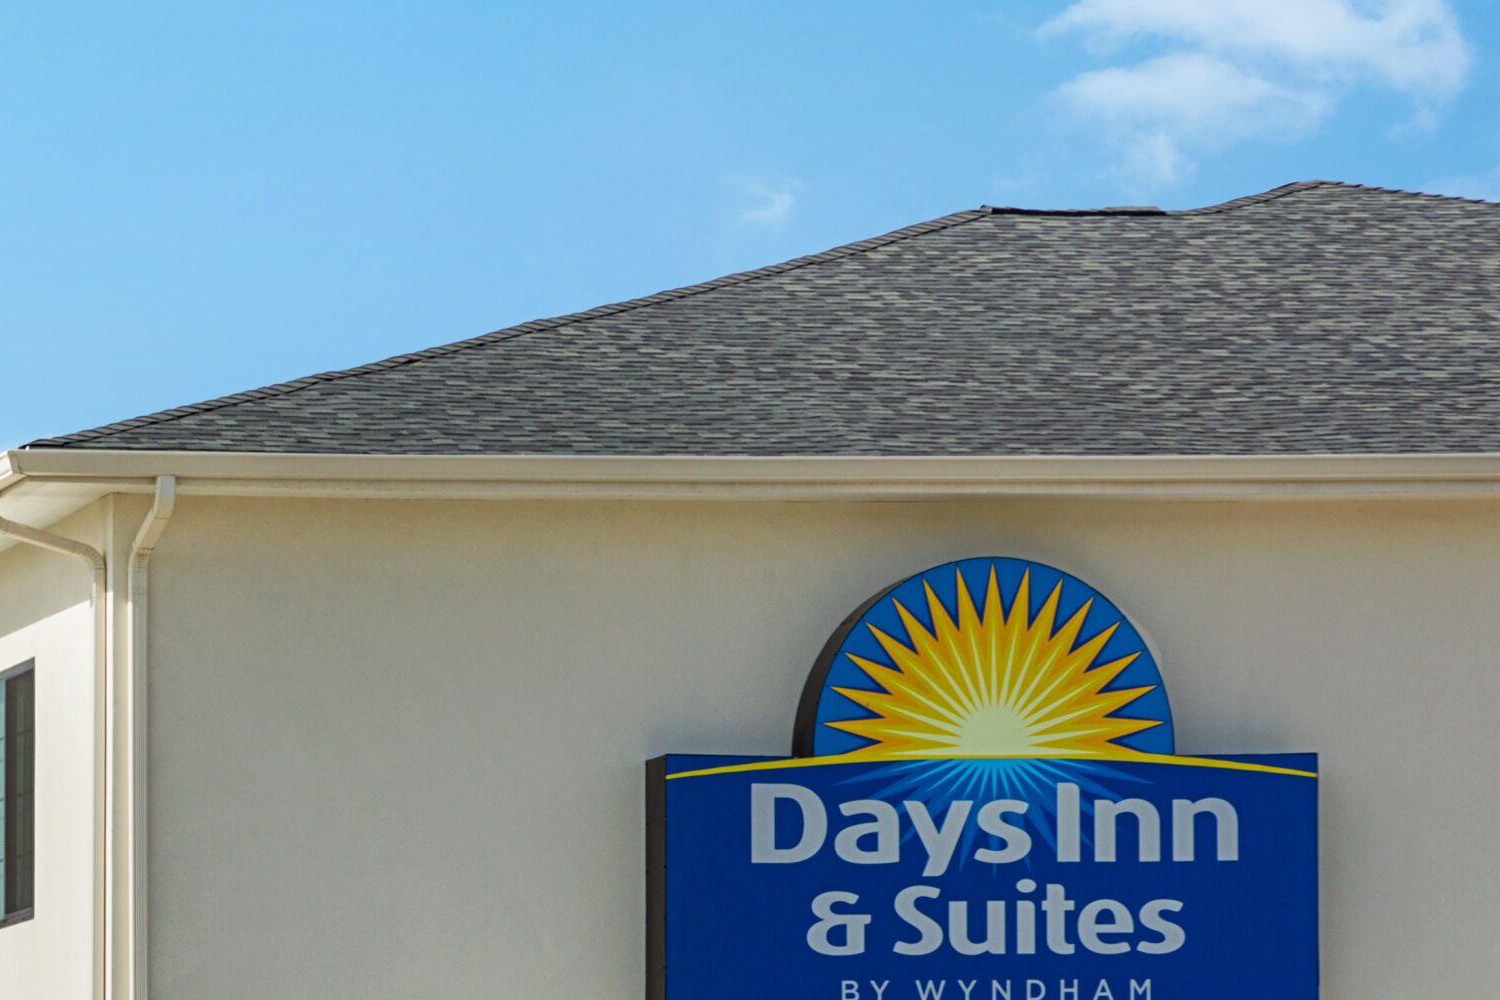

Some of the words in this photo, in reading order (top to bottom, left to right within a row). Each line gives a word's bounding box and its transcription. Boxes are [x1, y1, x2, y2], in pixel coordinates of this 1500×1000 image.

[750, 783, 1032, 877] Days
[1056, 782, 1239, 862] Inn
[806, 891, 872, 956] &
[893, 879, 1187, 956] Suites
